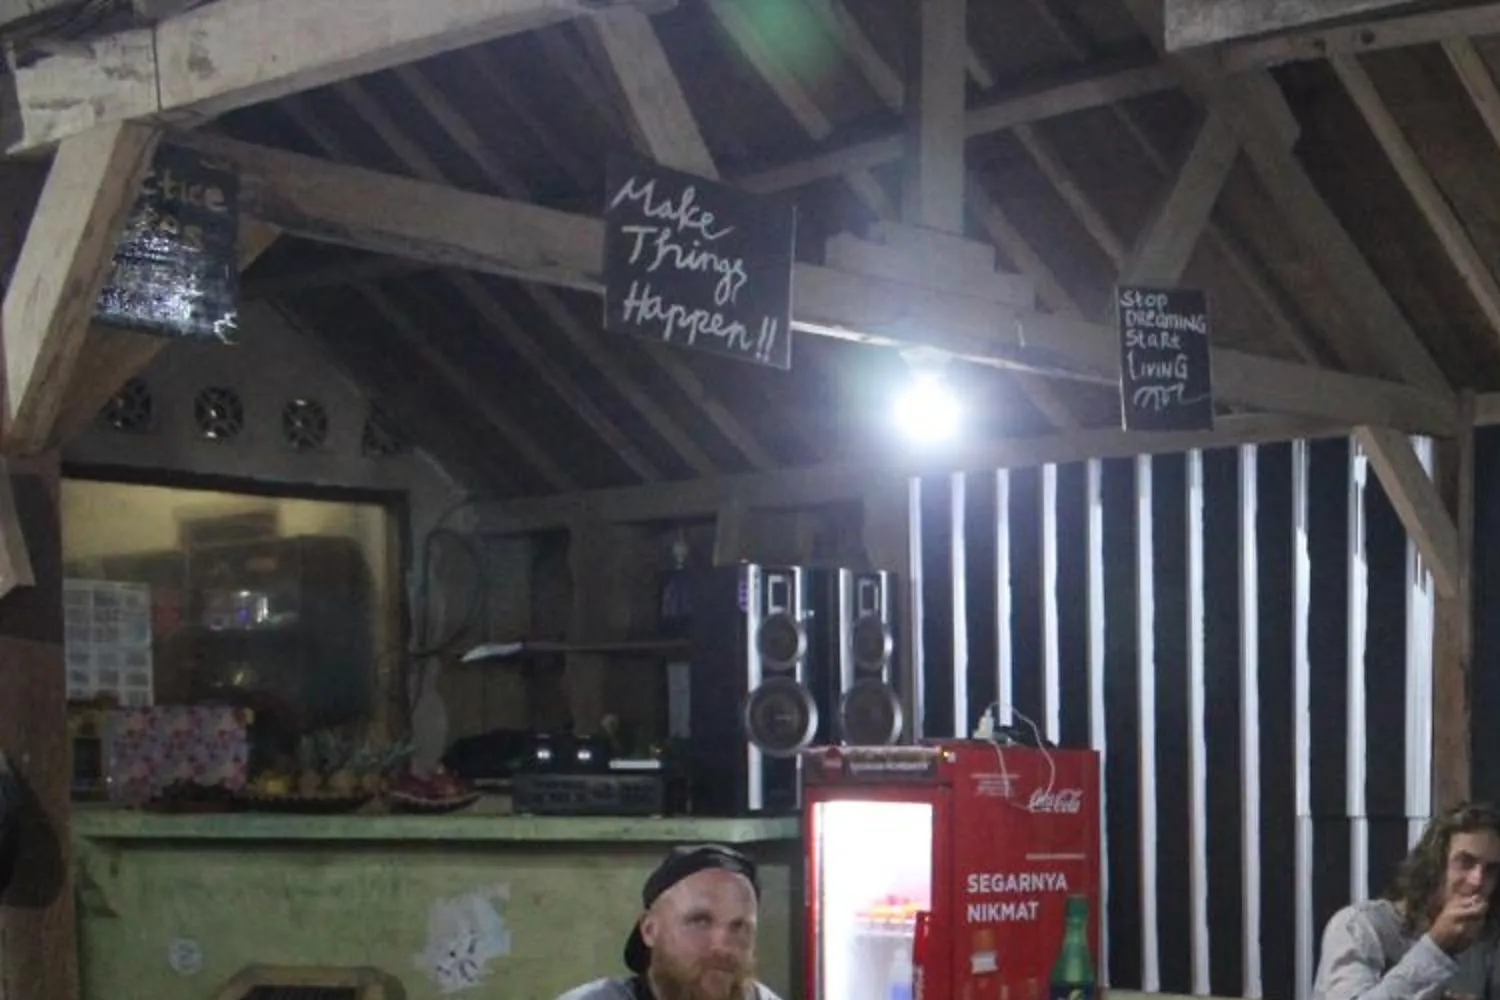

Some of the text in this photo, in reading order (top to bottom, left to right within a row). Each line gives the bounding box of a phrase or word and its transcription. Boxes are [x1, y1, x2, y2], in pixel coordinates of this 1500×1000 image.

[610, 177, 735, 240] Make
[621, 228, 748, 306] Things
[623, 280, 778, 363] Happen!!
[967, 873, 1069, 894] SEGARNYA
[967, 901, 1039, 923] NIKMAT
